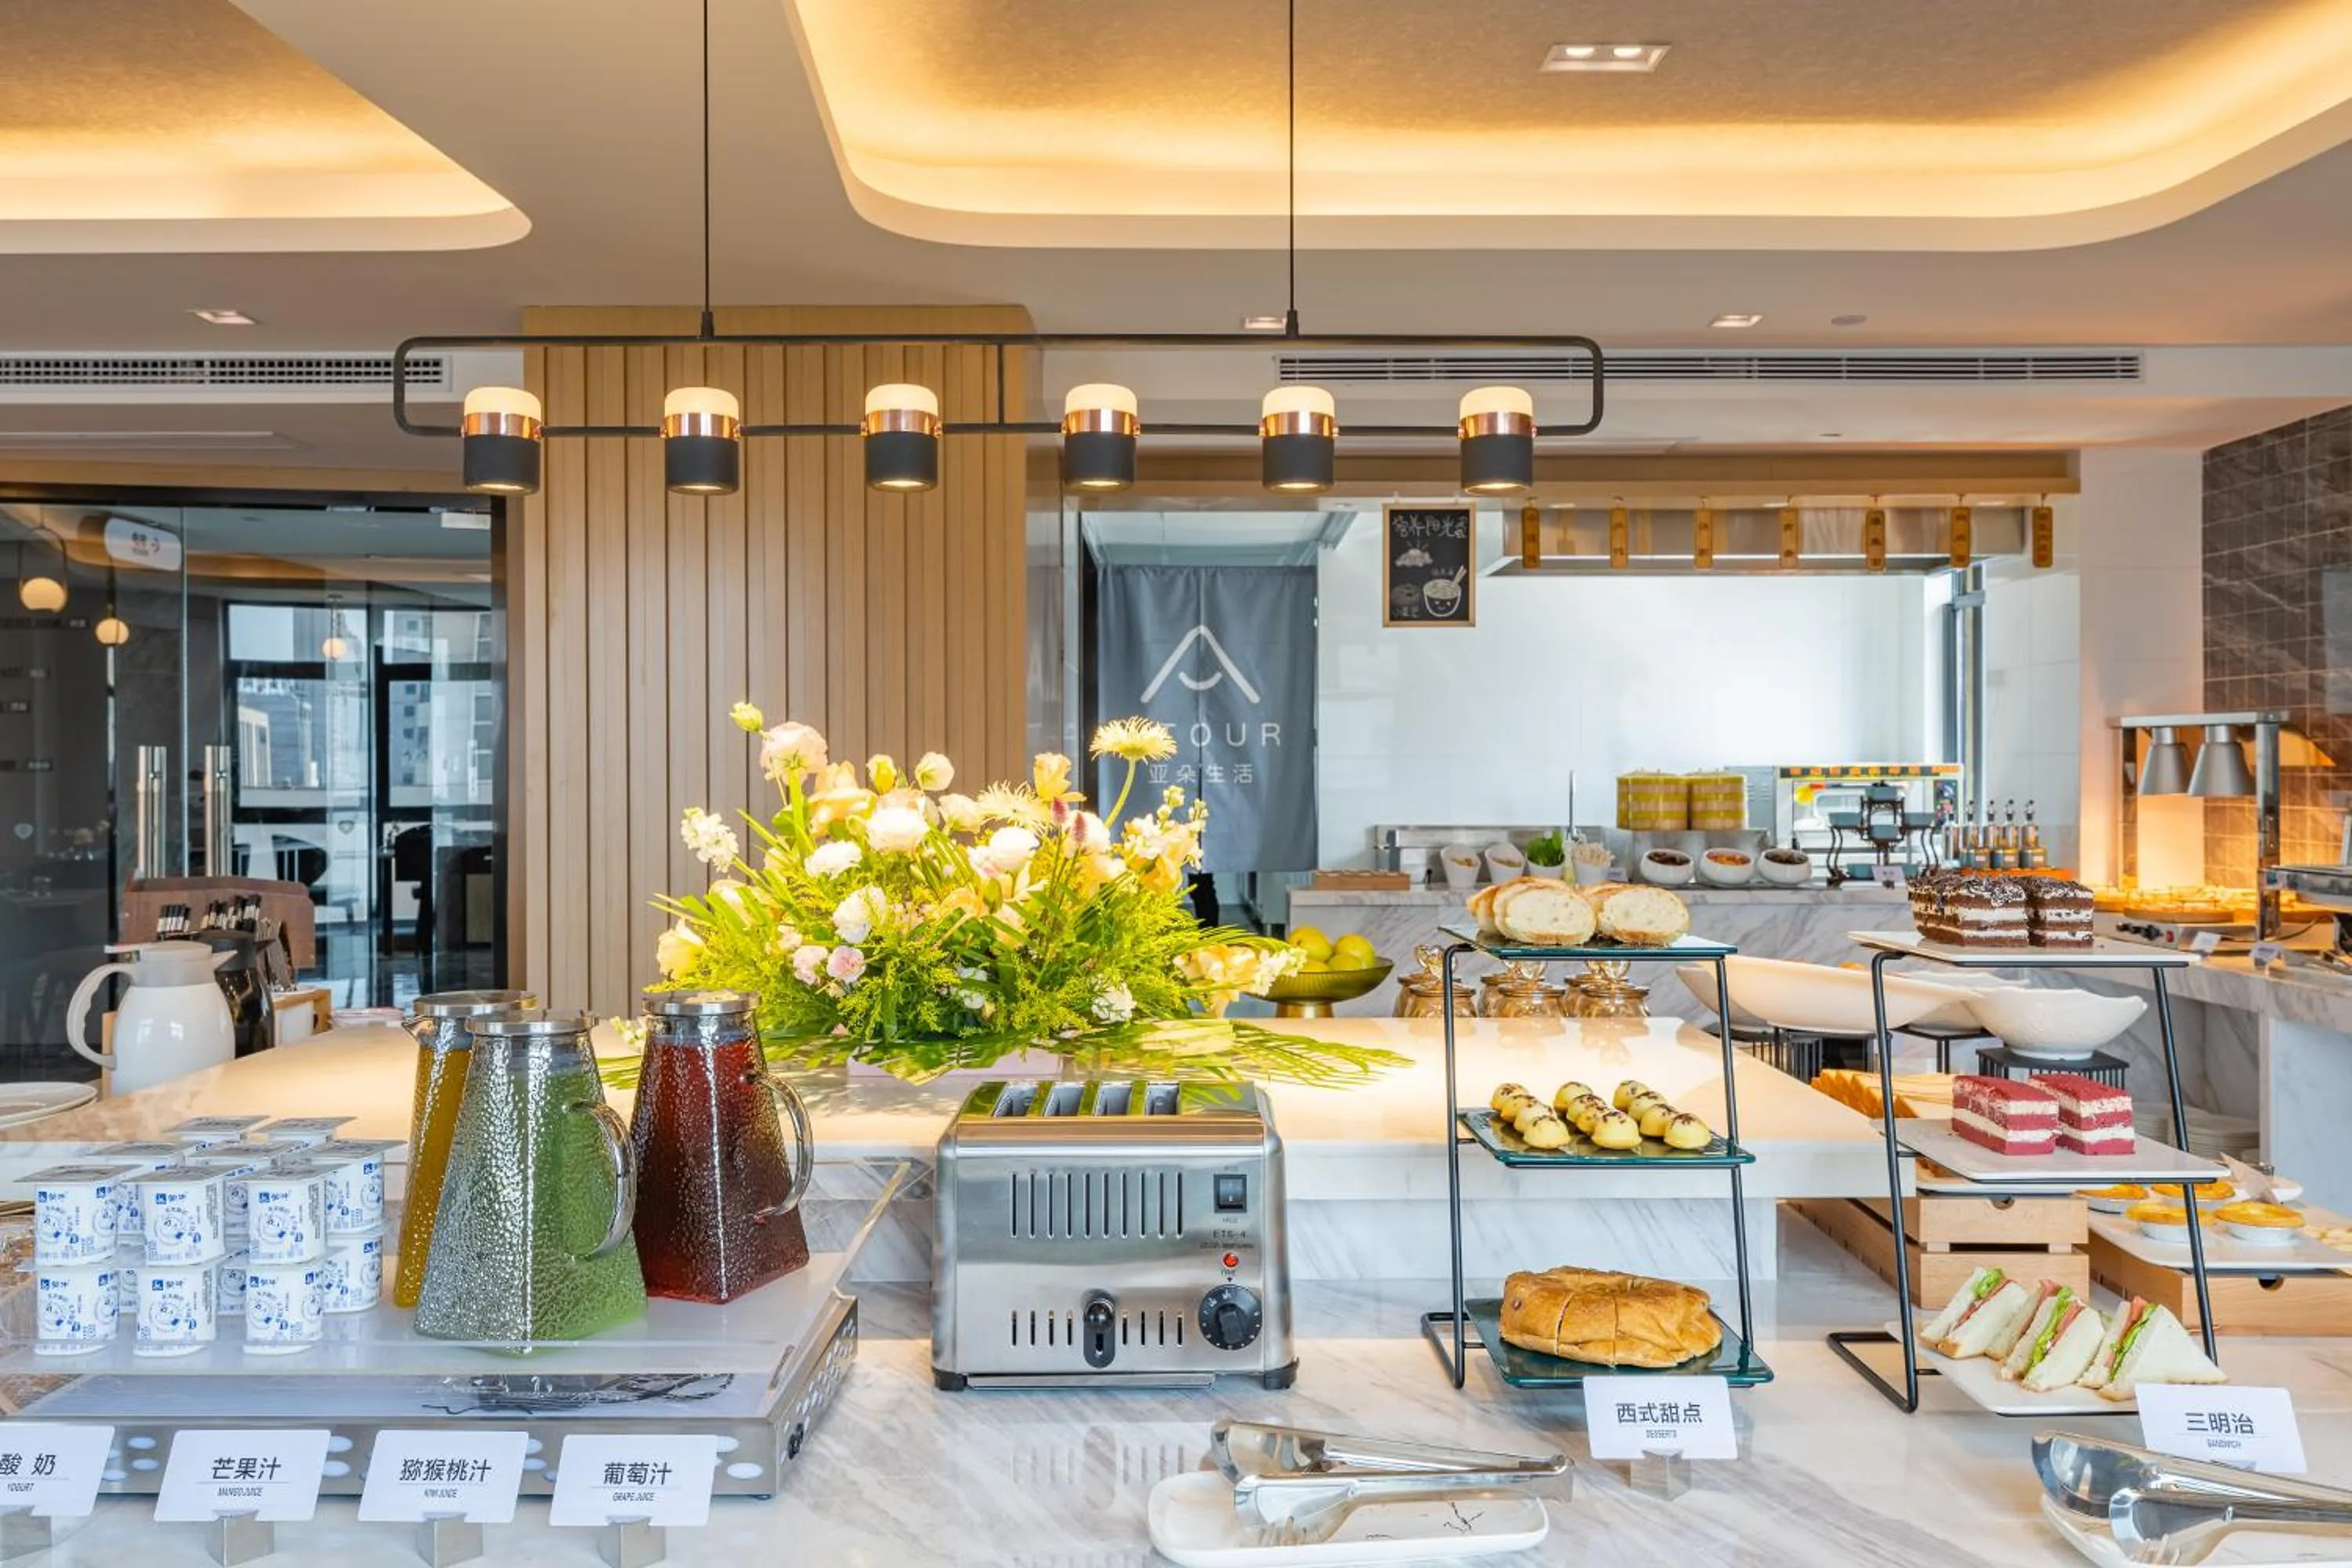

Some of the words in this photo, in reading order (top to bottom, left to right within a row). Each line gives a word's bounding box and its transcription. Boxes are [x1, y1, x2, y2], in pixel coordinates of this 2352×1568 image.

[1148, 763, 1254, 784] 亚朵生活
[1615, 1401, 1703, 1425] 西式甜点
[2184, 1411, 2255, 1435] 三明治
[212, 1456, 281, 1481] 芒果汁
[398, 1457, 492, 1483] 猕猴桃汁
[603, 1461, 673, 1486] 葡萄汁
[612, 1491, 634, 1501] GRAPE
